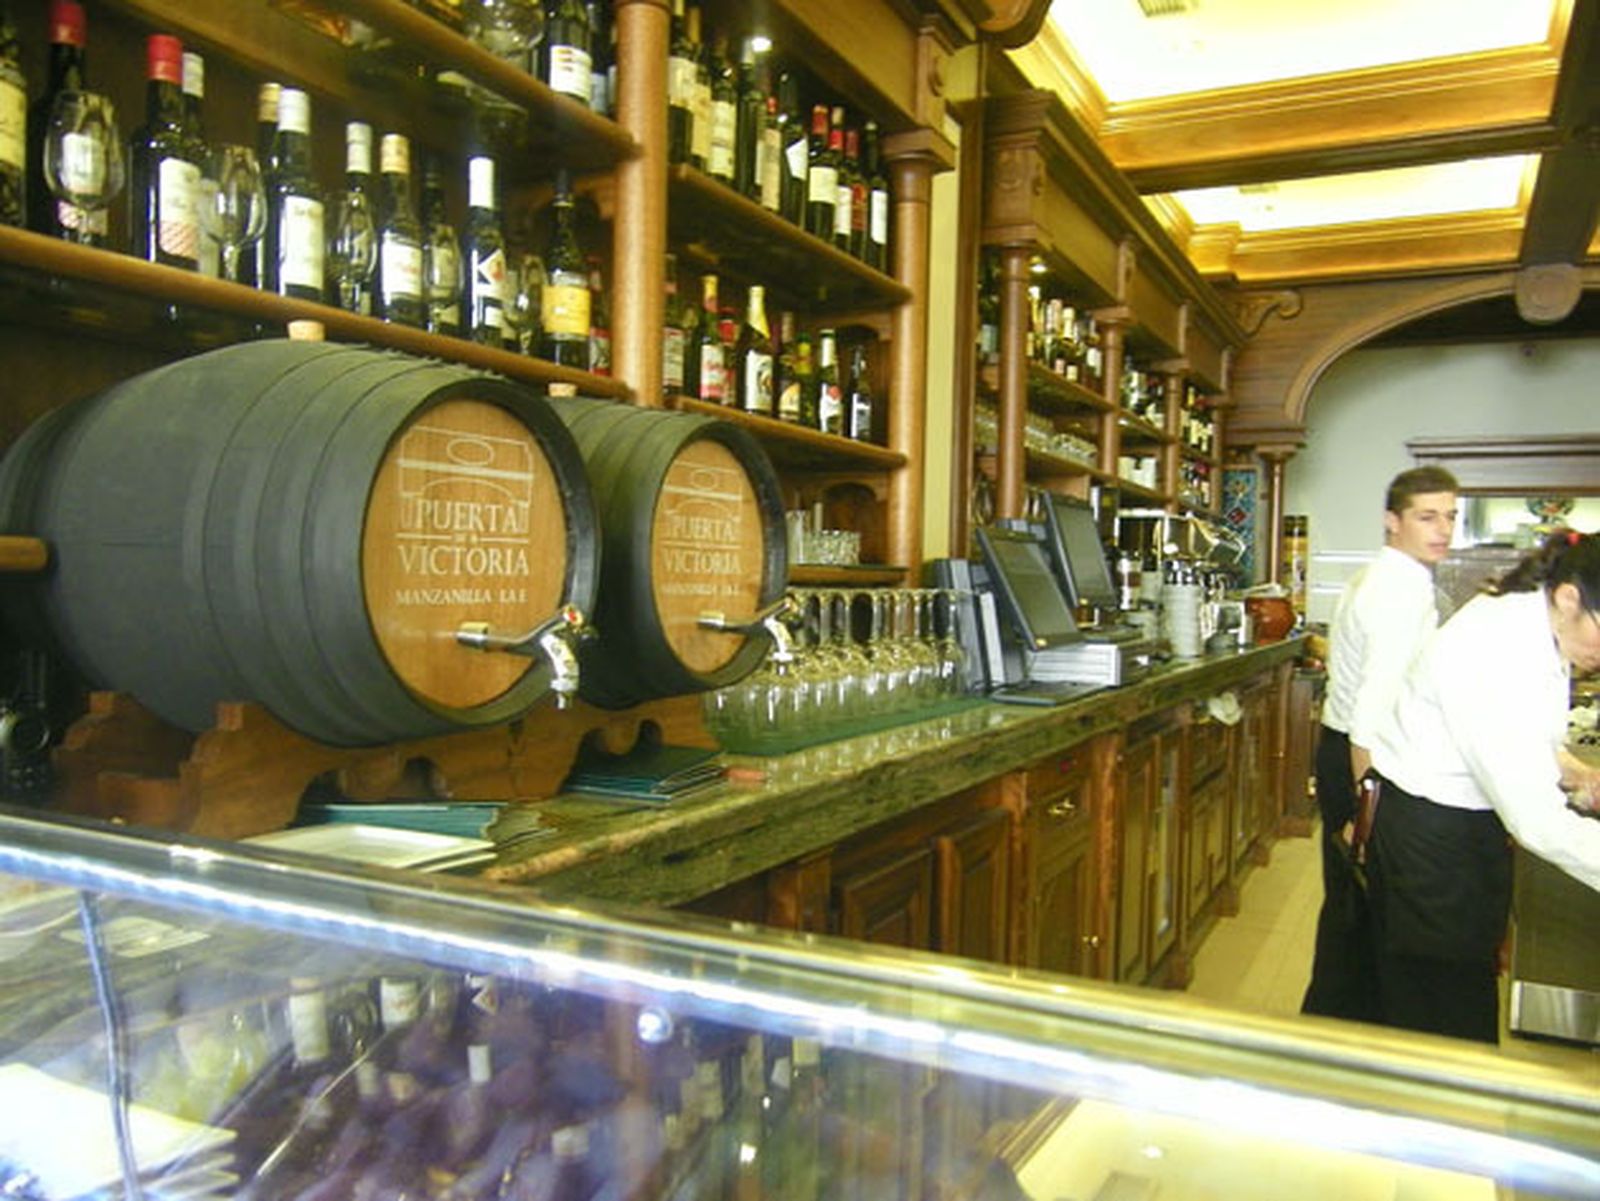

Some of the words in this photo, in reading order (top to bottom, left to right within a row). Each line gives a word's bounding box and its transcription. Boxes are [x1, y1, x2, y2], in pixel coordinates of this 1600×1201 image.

[416, 499, 518, 533] PUERTA
[673, 515, 736, 542] PUERTA
[397, 545, 529, 576] VICTORIA
[661, 548, 741, 576] VICTORIA
[396, 588, 492, 605] MANZANILLA
